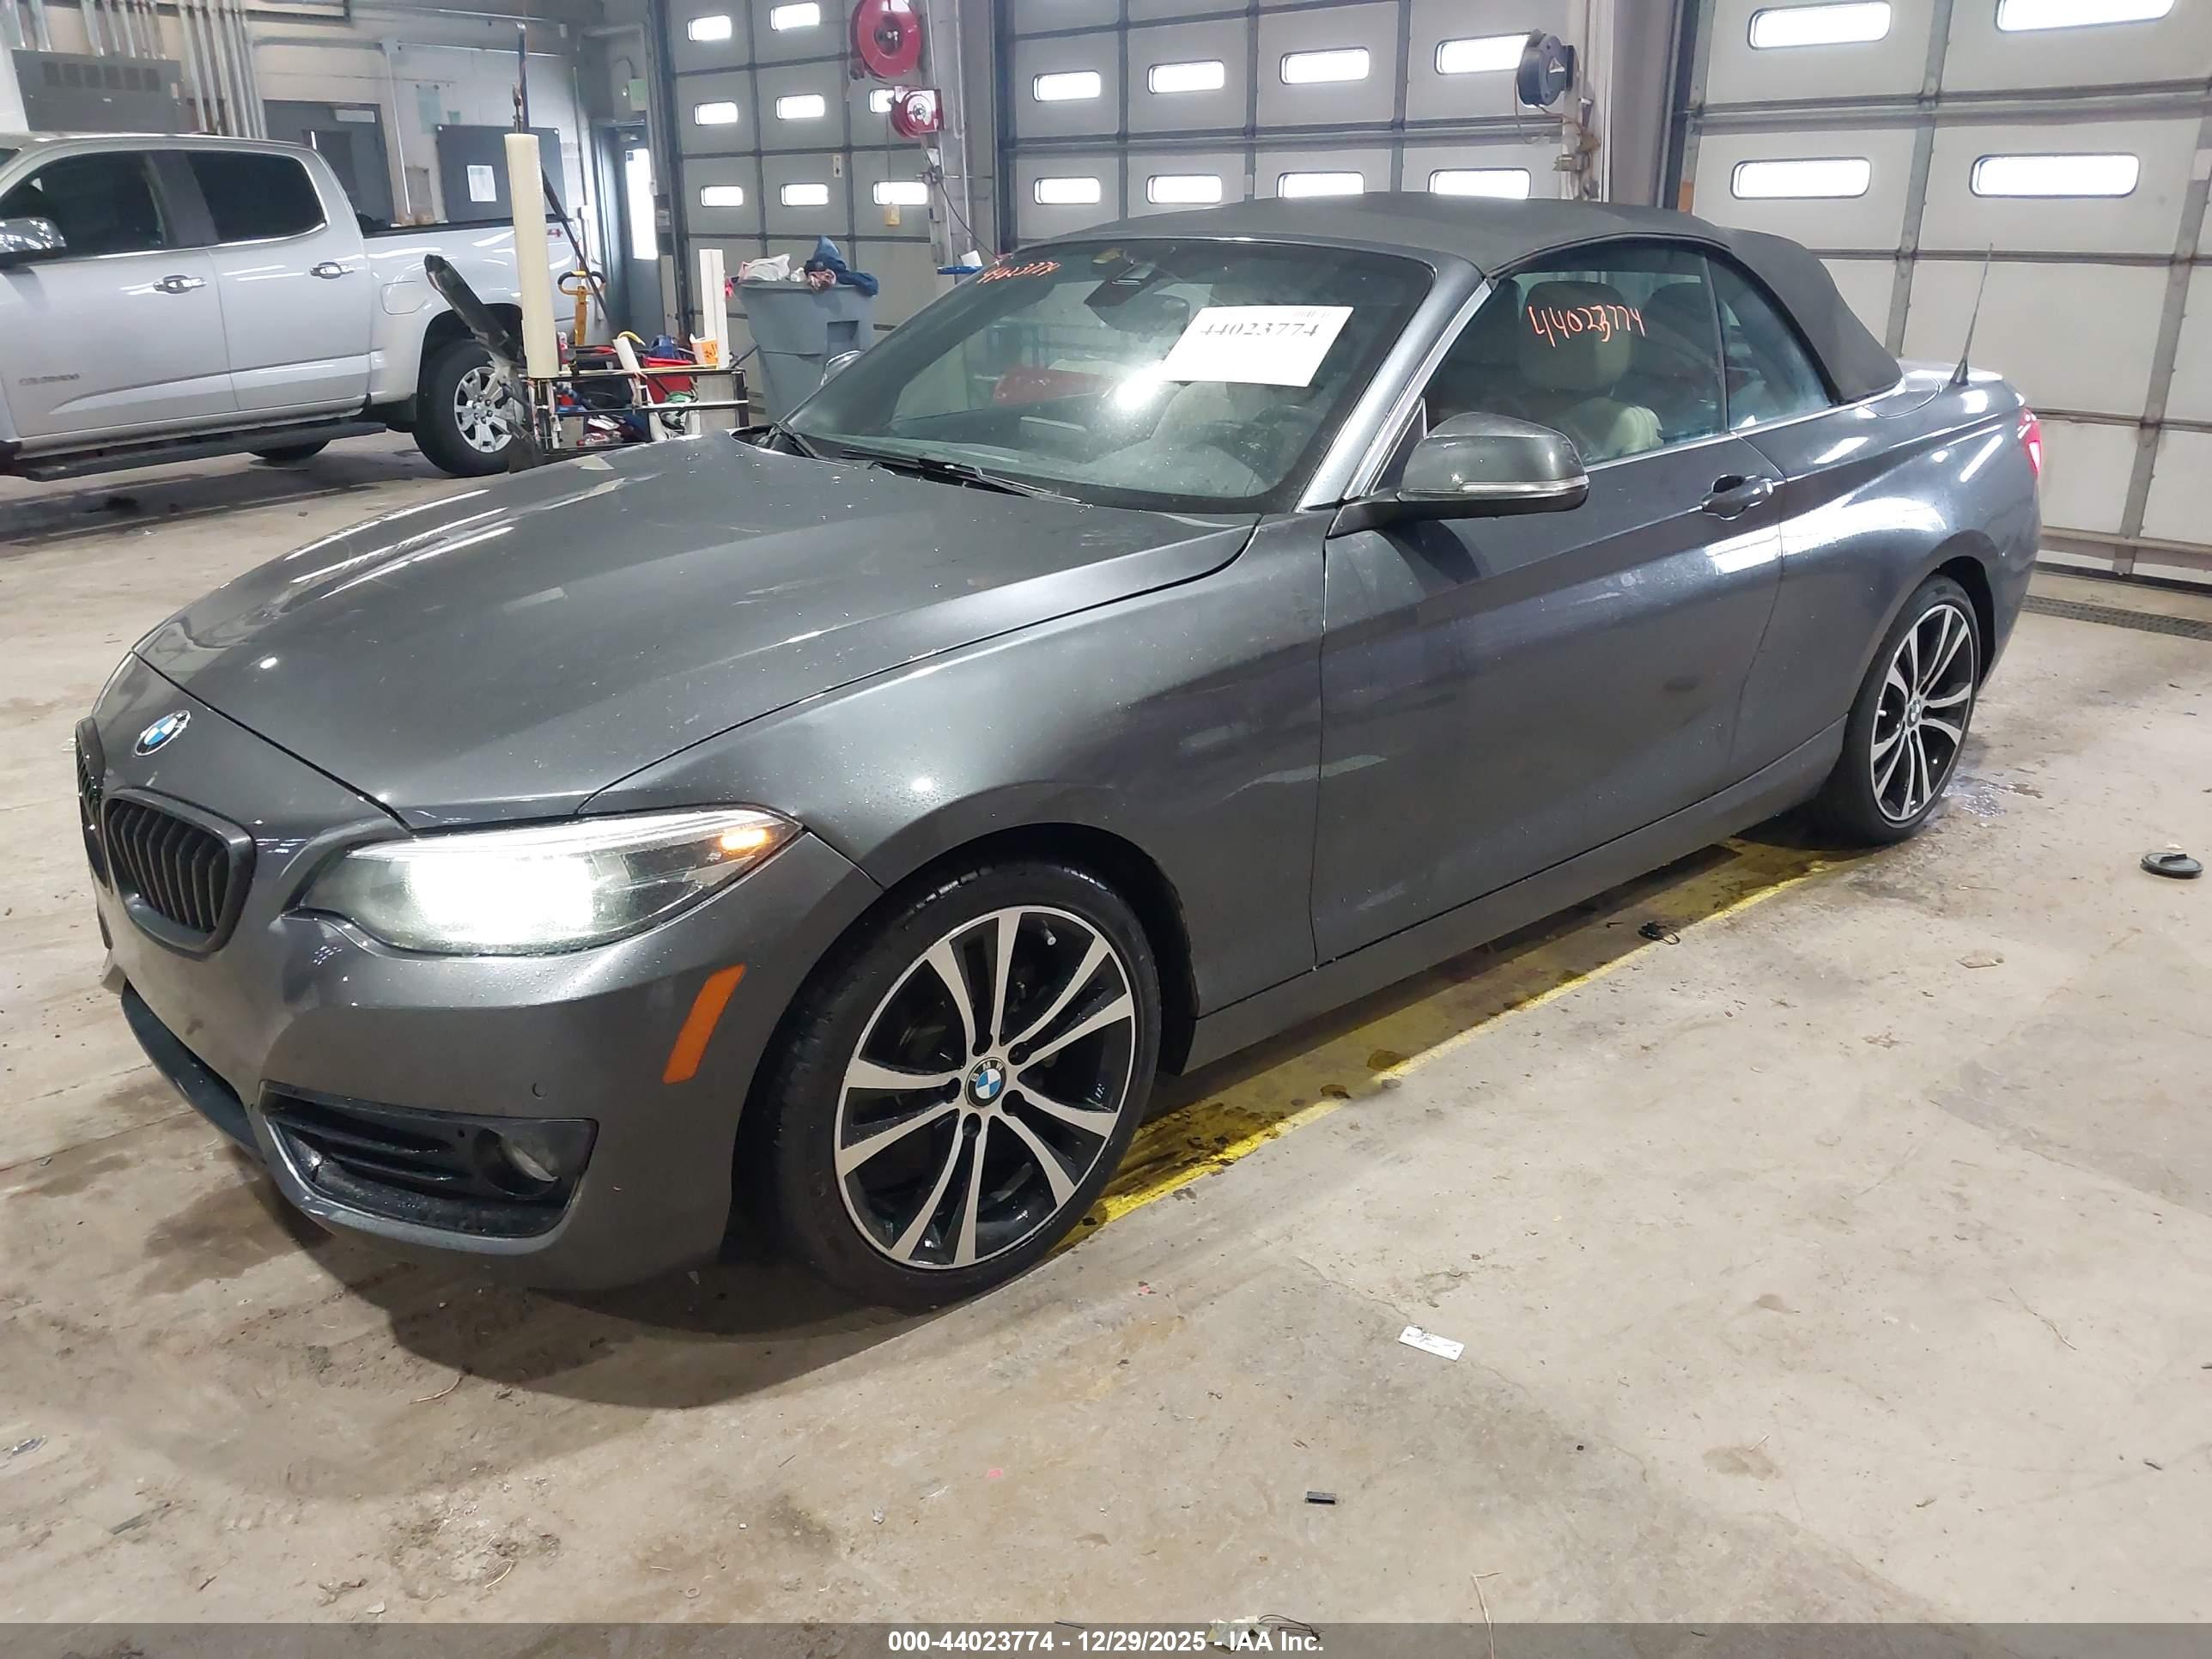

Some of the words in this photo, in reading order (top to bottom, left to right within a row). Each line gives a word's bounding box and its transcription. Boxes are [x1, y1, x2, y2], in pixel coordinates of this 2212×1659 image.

[1200, 321, 1320, 337] 44023774
[1528, 304, 1646, 348] 44023774
[970, 1060, 1004, 1082] BMW
